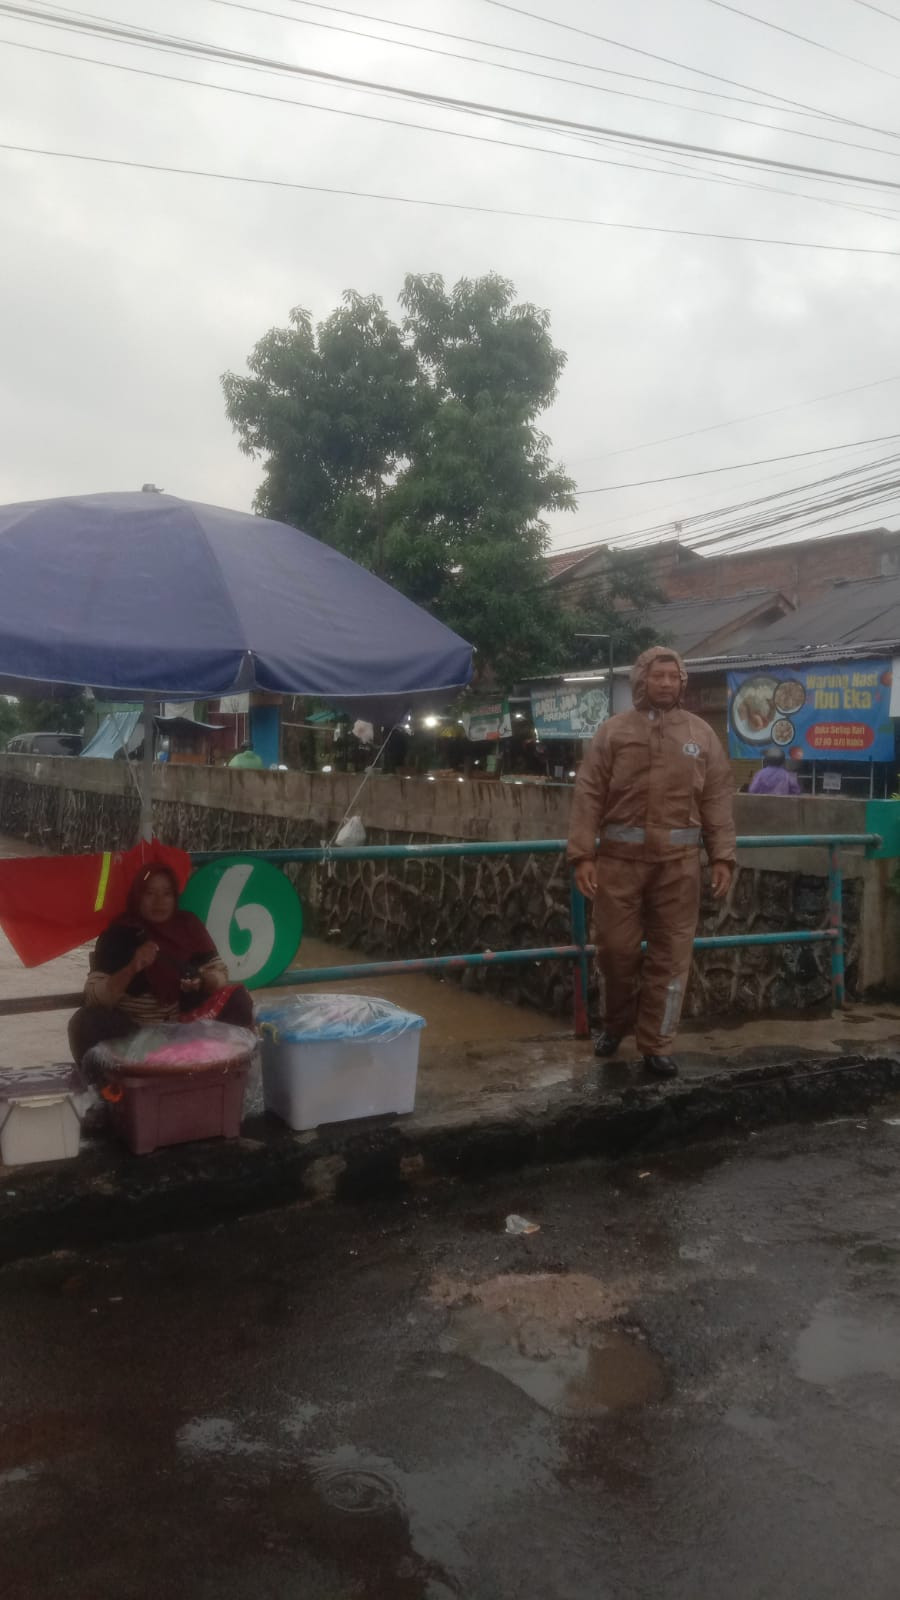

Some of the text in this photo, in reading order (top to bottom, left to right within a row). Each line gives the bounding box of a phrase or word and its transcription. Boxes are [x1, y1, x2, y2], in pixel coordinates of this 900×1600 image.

[806, 671, 878, 688] Warung Nasi
[815, 688, 872, 709] Ibu Eka
[206, 864, 275, 981] 6
